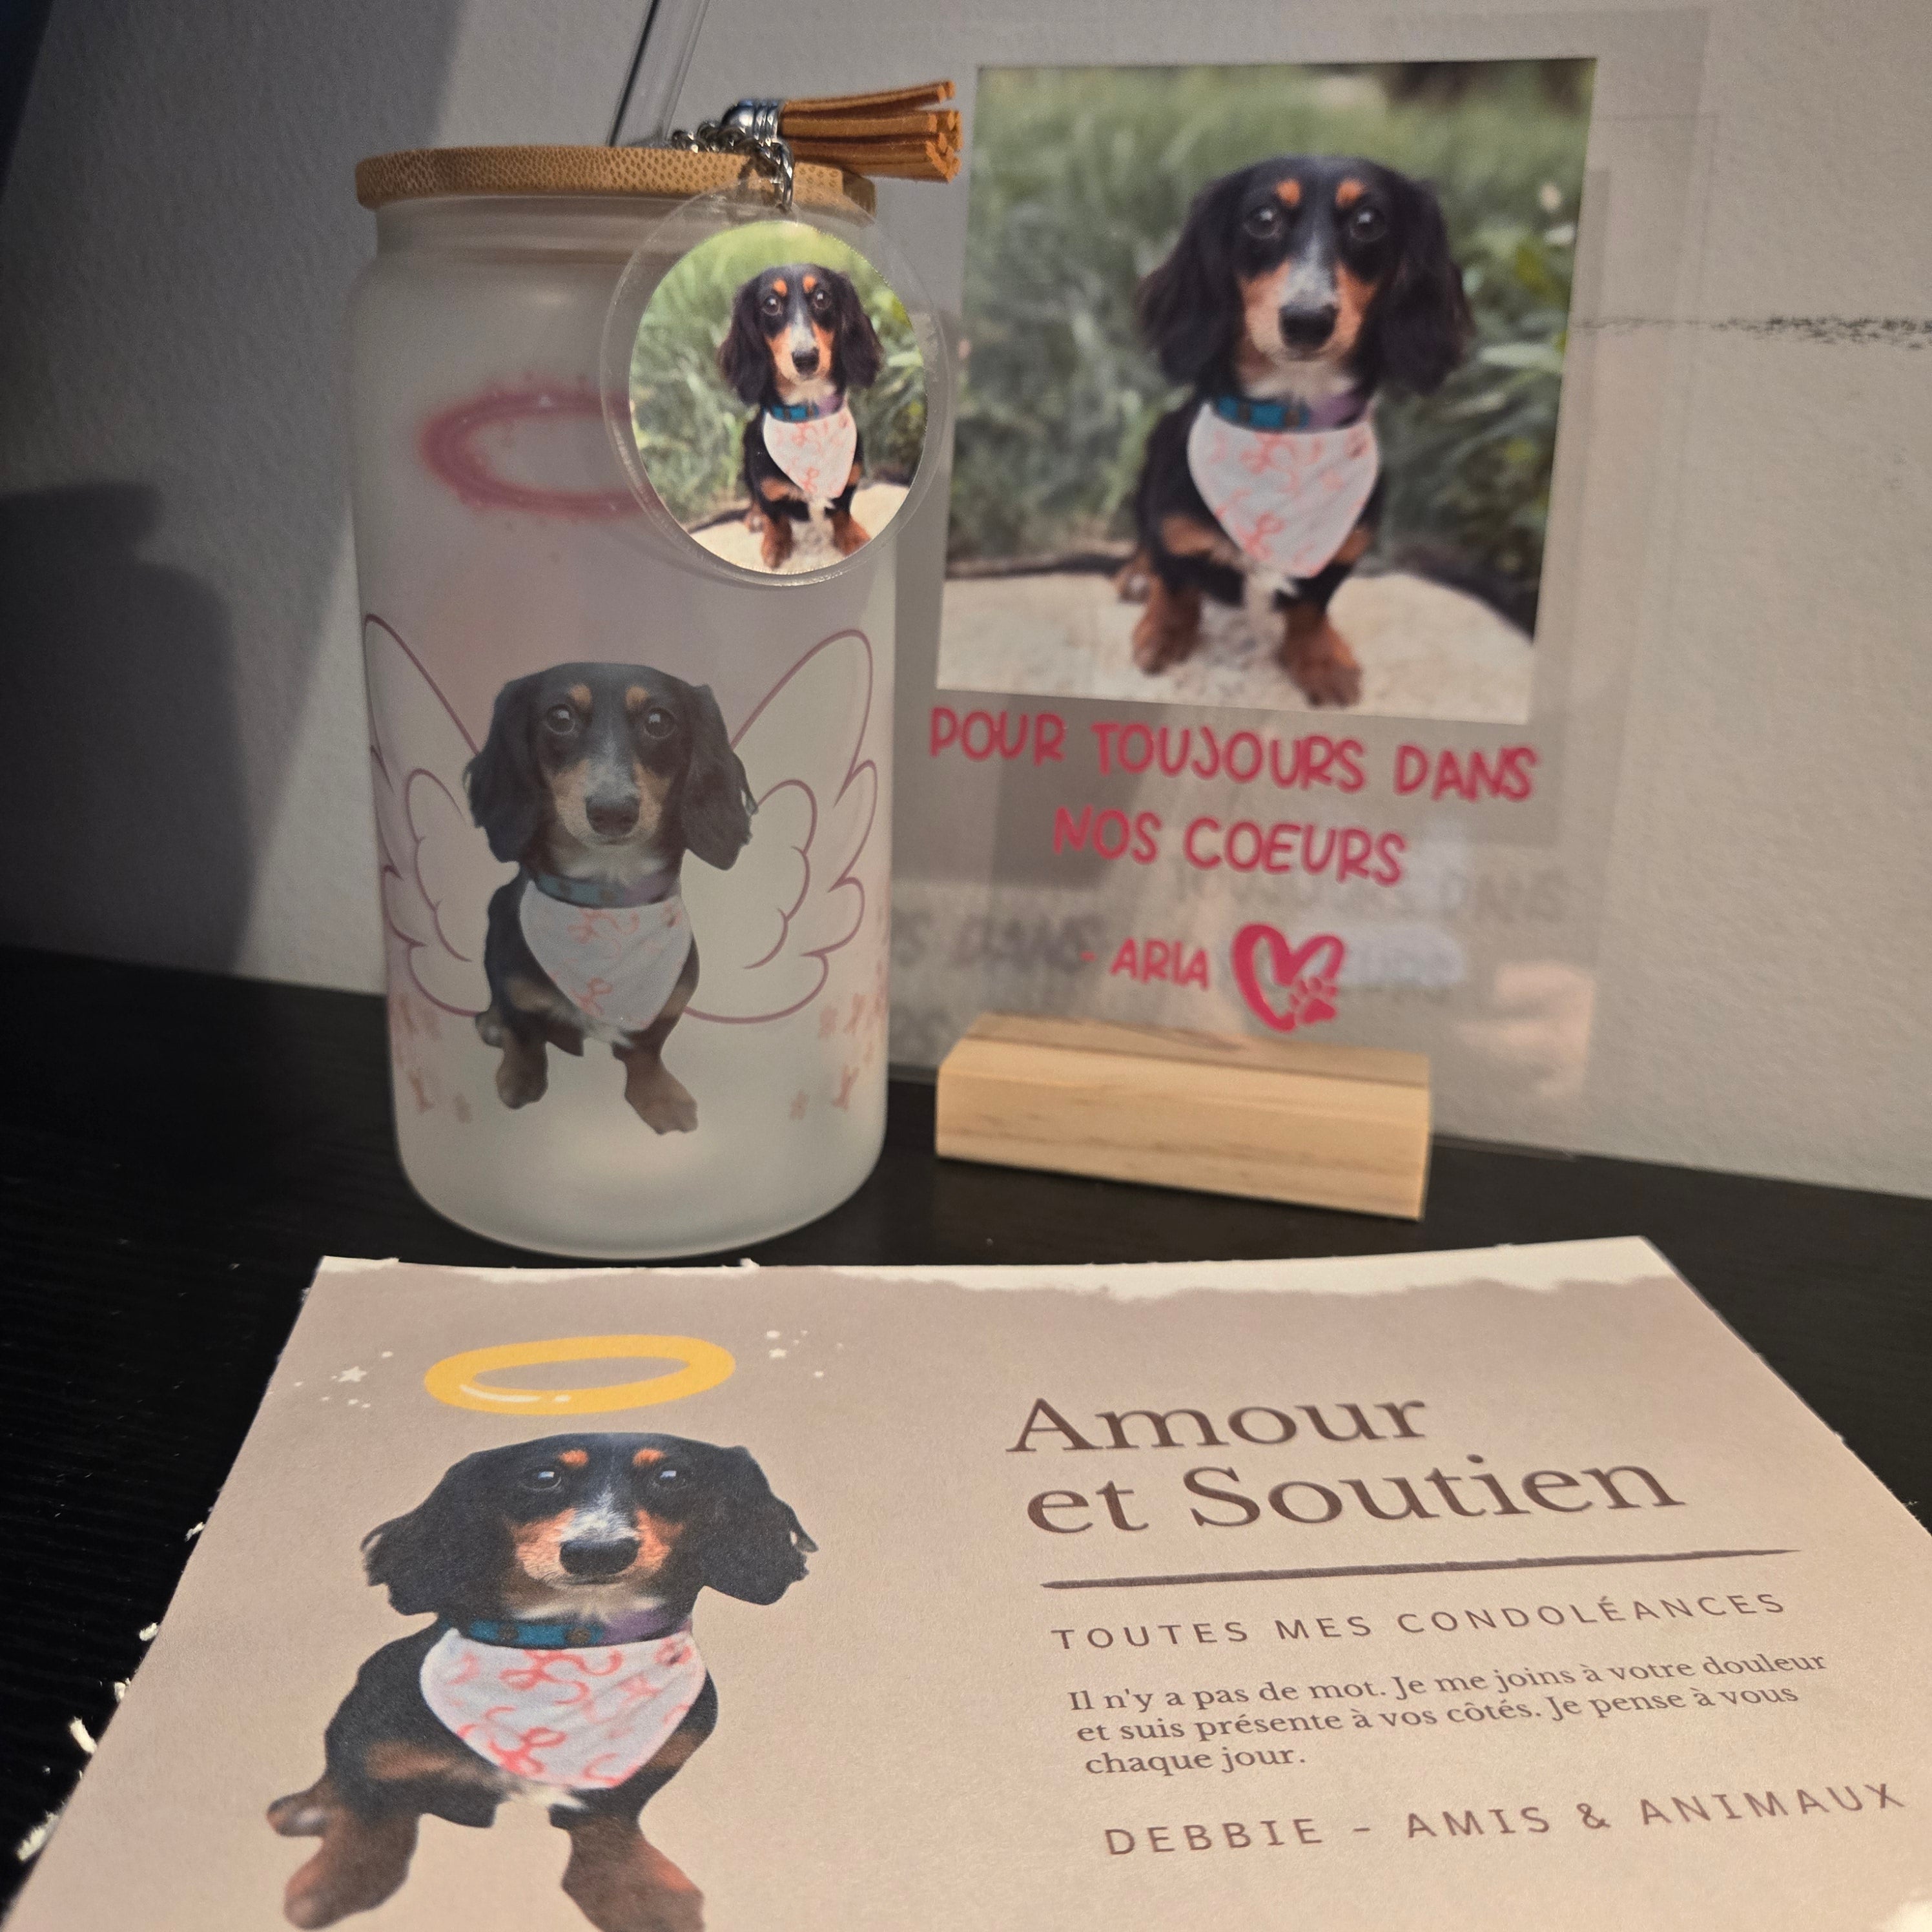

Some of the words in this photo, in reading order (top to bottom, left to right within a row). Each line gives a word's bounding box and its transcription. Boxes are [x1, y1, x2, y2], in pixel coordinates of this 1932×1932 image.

[929, 705, 1067, 767] POUR
[1090, 720, 1366, 794] TOUJOURS
[1394, 744, 1539, 803] DANS
[1053, 805, 1163, 865] NOS
[1182, 815, 1409, 887] COEURS
[1080, 950, 1096, 962] -
[1109, 936, 1211, 992] ARIA
[1005, 1397, 1427, 1454] Amour
[1026, 1480, 1150, 1535] et
[1182, 1453, 1687, 1528] Soutien
[1050, 1621, 1249, 1651] TOUTES
[1274, 1615, 1372, 1641] MES
[1396, 1593, 1785, 1635] CONDOLÉANCES
[1067, 1689, 1095, 1712] Il
[1103, 1687, 1154, 1714] n'y
[1164, 1691, 1186, 1707] a
[1192, 1688, 1250, 1711] pas
[1258, 1680, 1299, 1702] de
[1307, 1680, 1388, 1700] mot.
[1391, 1675, 1427, 1701] Je
[1434, 1675, 1488, 1693] me
[1494, 1665, 1577, 1695] joins
[1581, 1661, 1604, 1683] à
[1607, 1662, 1696, 1681] votre
[1701, 1652, 1827, 1676] douleur
[1076, 1720, 1111, 1743] et
[1119, 1718, 1186, 1740] suis
[1193, 1713, 1344, 1743] présente
[1351, 1707, 1374, 1729] à
[1377, 1710, 1439, 1727] vos
[1446, 1698, 1543, 1724] côtés.
[1545, 1695, 1583, 1723] Je
[1587, 1694, 1687, 1720] pense
[1692, 1686, 1716, 1707] à
[1717, 1687, 1800, 1706] vous
[1084, 1751, 1213, 1778] chaque
[1220, 1745, 1306, 1774] jour.
[1104, 1817, 1324, 1856] DEBBIE
[1351, 1826, 1372, 1834] -
[1406, 1805, 1551, 1840] AMIS
[1575, 1802, 1612, 1831] &
[1639, 1782, 1906, 1827] ANIMAUX
